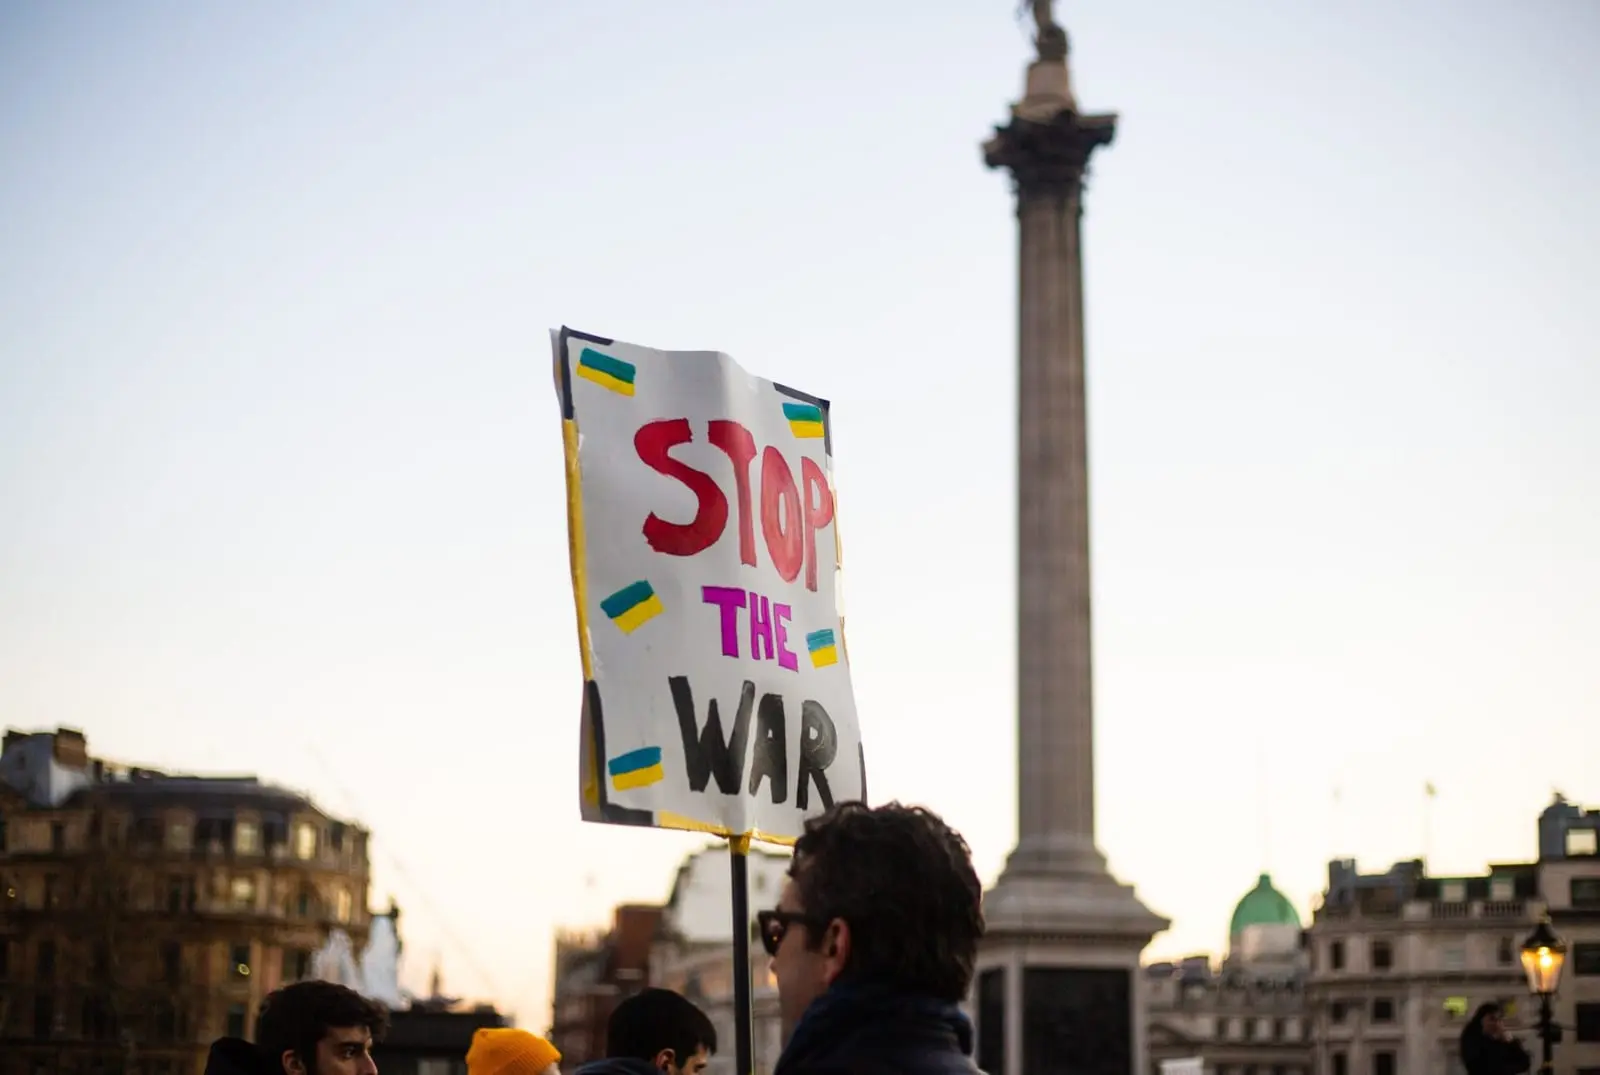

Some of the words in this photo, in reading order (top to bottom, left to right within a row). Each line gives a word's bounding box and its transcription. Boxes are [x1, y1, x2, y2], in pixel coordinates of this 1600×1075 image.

[634, 417, 834, 592] STOP
[701, 585, 799, 672] THE
[668, 675, 838, 810] WAR
